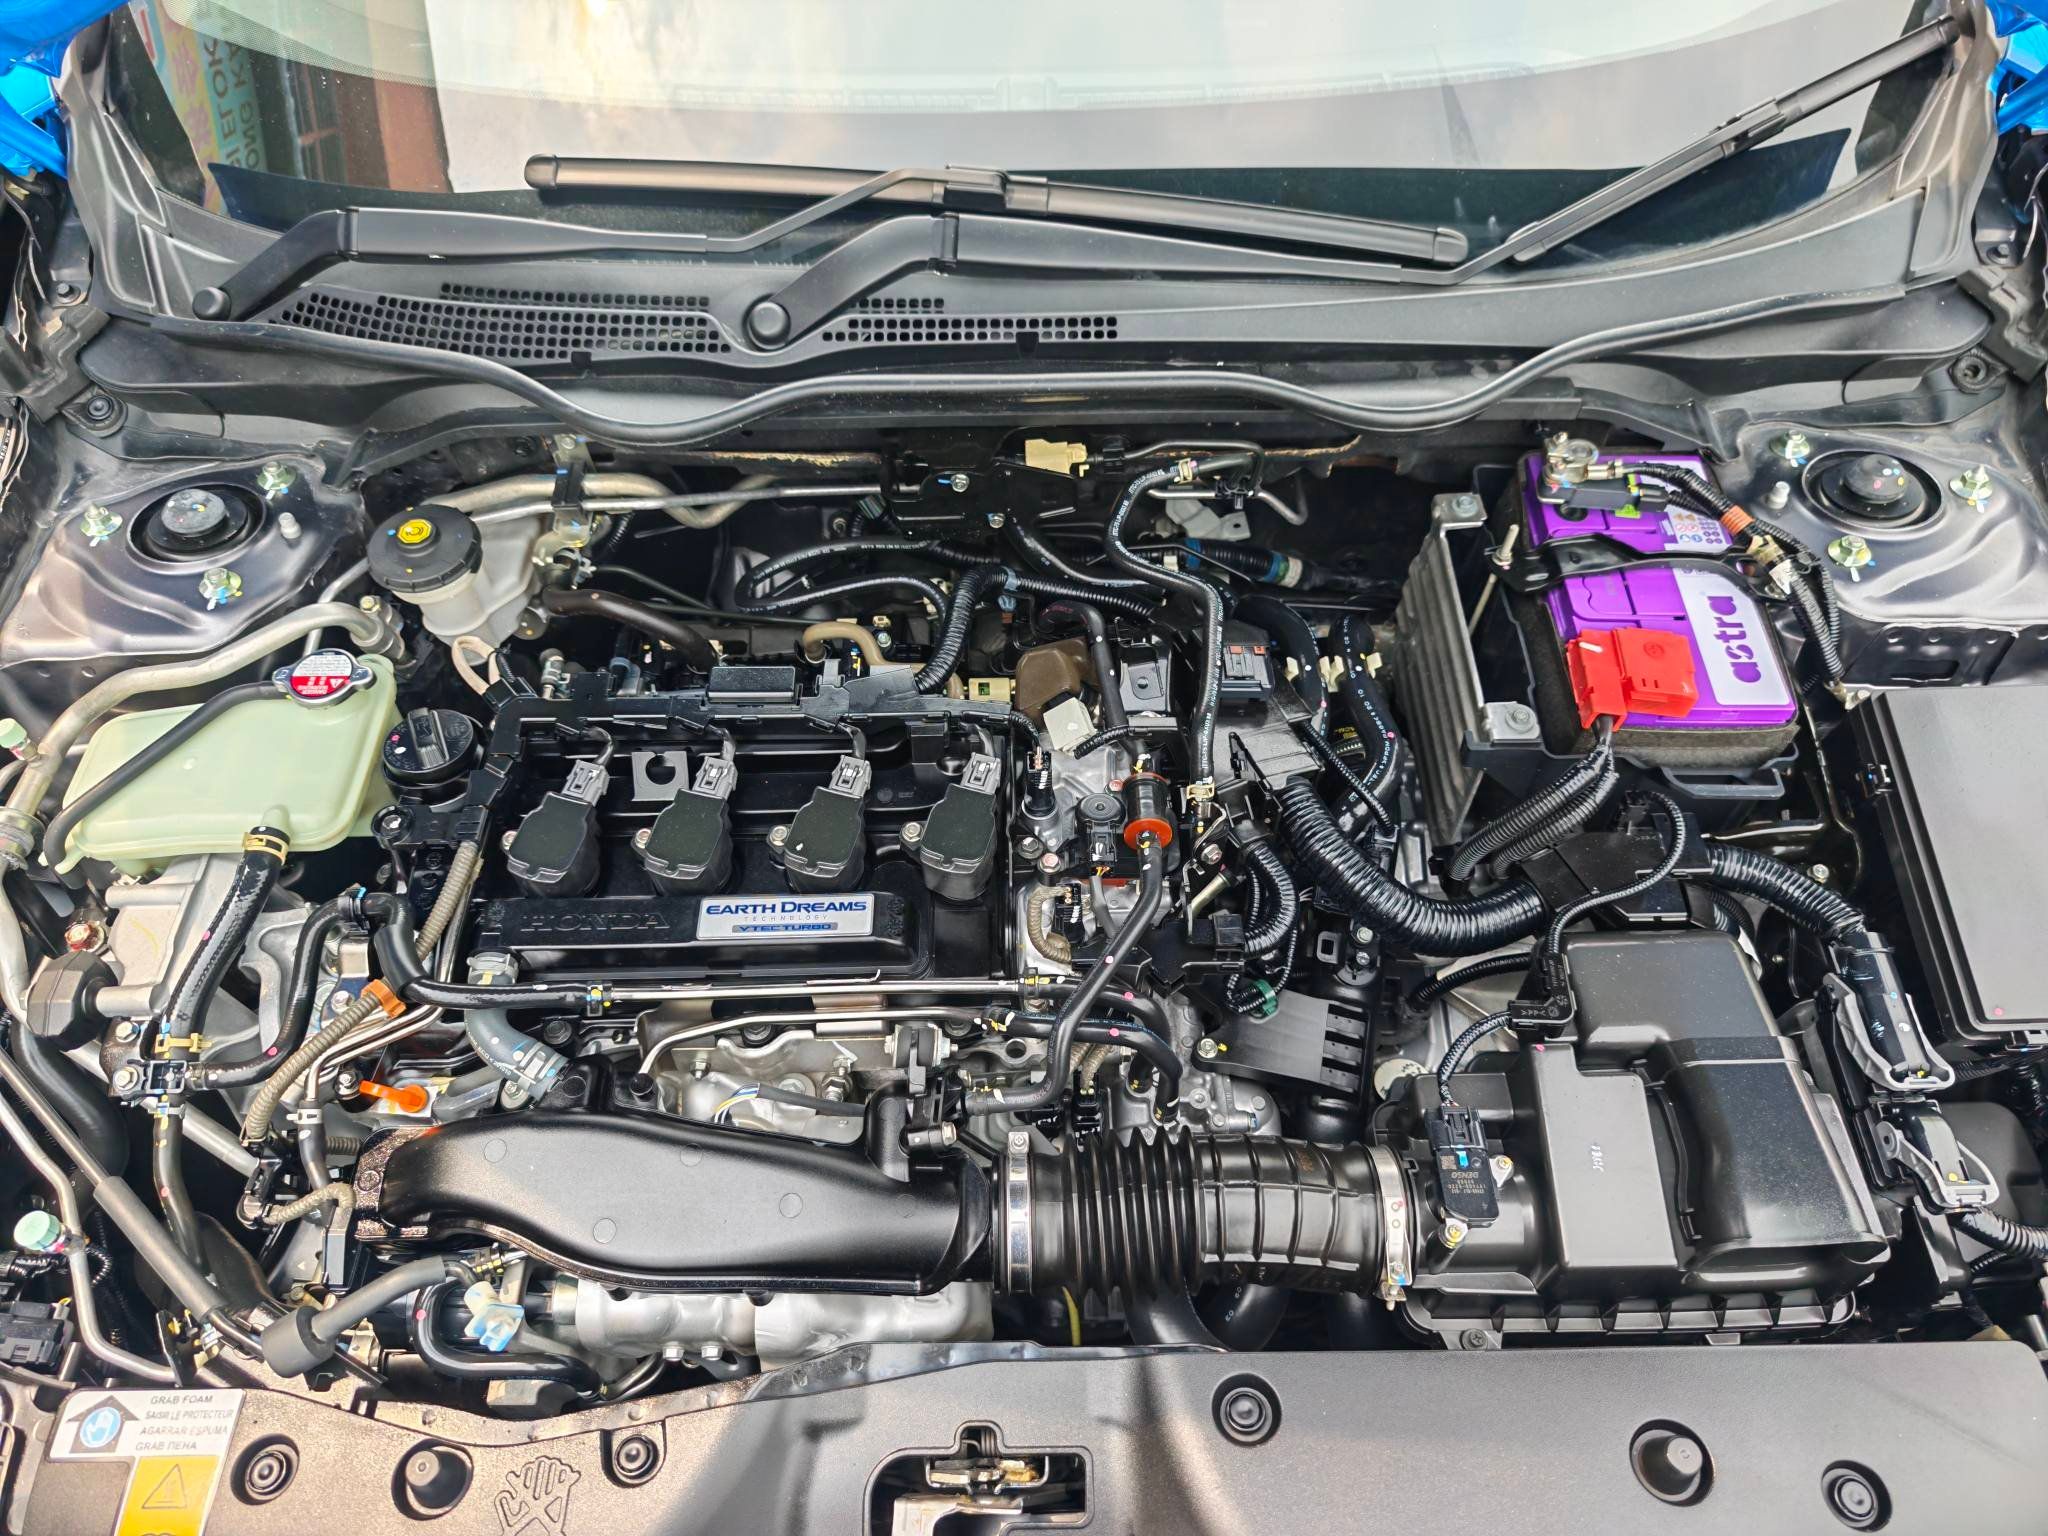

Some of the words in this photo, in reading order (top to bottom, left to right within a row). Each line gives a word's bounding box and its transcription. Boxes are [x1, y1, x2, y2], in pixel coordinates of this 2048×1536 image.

[1707, 596, 1762, 683] astra
[706, 902, 776, 915] EARTH
[781, 901, 867, 914] DREAMS
[520, 912, 671, 932] HONDA
[744, 914, 829, 922] TECHNOLOGY
[782, 923, 832, 931] TURBO
[150, 1396, 180, 1404] GRAB
[182, 1395, 213, 1404] FOAM
[170, 1411, 180, 1421] LE
[183, 1410, 233, 1419] PROTECTEUR
